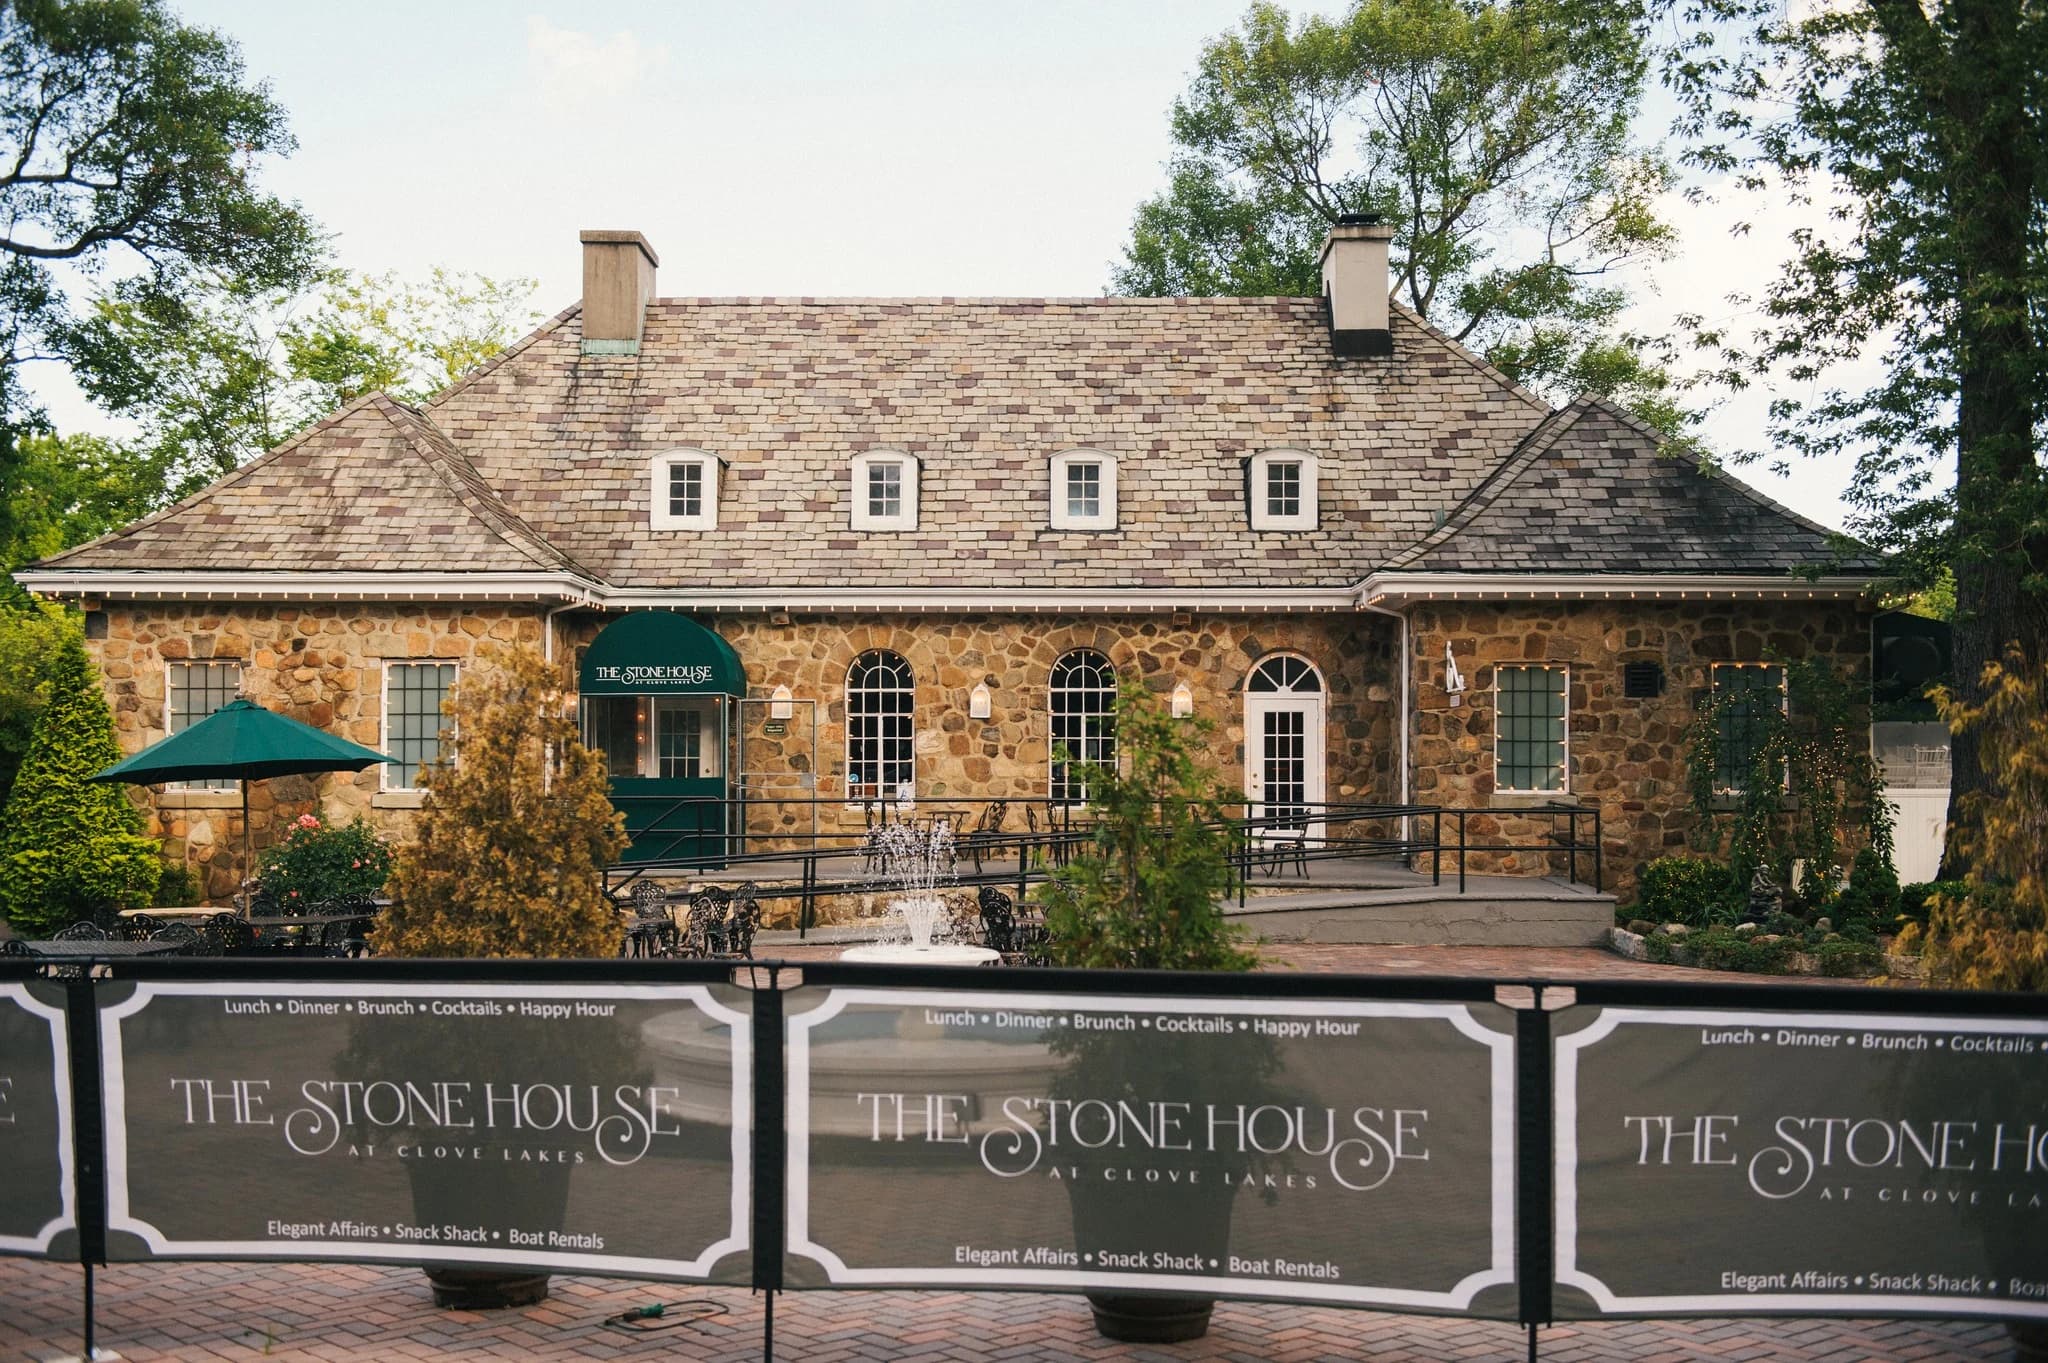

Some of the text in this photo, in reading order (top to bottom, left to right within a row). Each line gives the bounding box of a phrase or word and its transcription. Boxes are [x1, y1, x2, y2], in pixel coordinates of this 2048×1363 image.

[596, 665, 712, 685] THE STONE HOUSE
[225, 999, 616, 1020] Lunch Dinner Brunch Cocktails Happy Hour
[925, 1009, 1362, 1038] Lunch Dinner Brunch Cocktails Happy Hour
[1702, 1028, 2035, 1054] Lunch Dinner Brunch Cocktails
[171, 1078, 681, 1166] THE STONE HOUSE
[348, 1144, 585, 1164] AT CLOVE LAKES
[858, 1092, 1430, 1191] THE STONE HOUSE
[1624, 1115, 2048, 1199] THE STONE H
[1048, 1165, 1318, 1190] AT CLOVE LAKES
[1819, 1186, 1853, 1201] AT
[1878, 1187, 1980, 1206] CLOVE
[268, 1219, 605, 1249] Elegant Affairs Snack Shack Boat Rentals
[955, 1245, 1340, 1279] Elegant Affairs Snack Shack Boat Rentals
[1721, 1270, 2048, 1297] Elegant Affairs Snack Shack Boa
